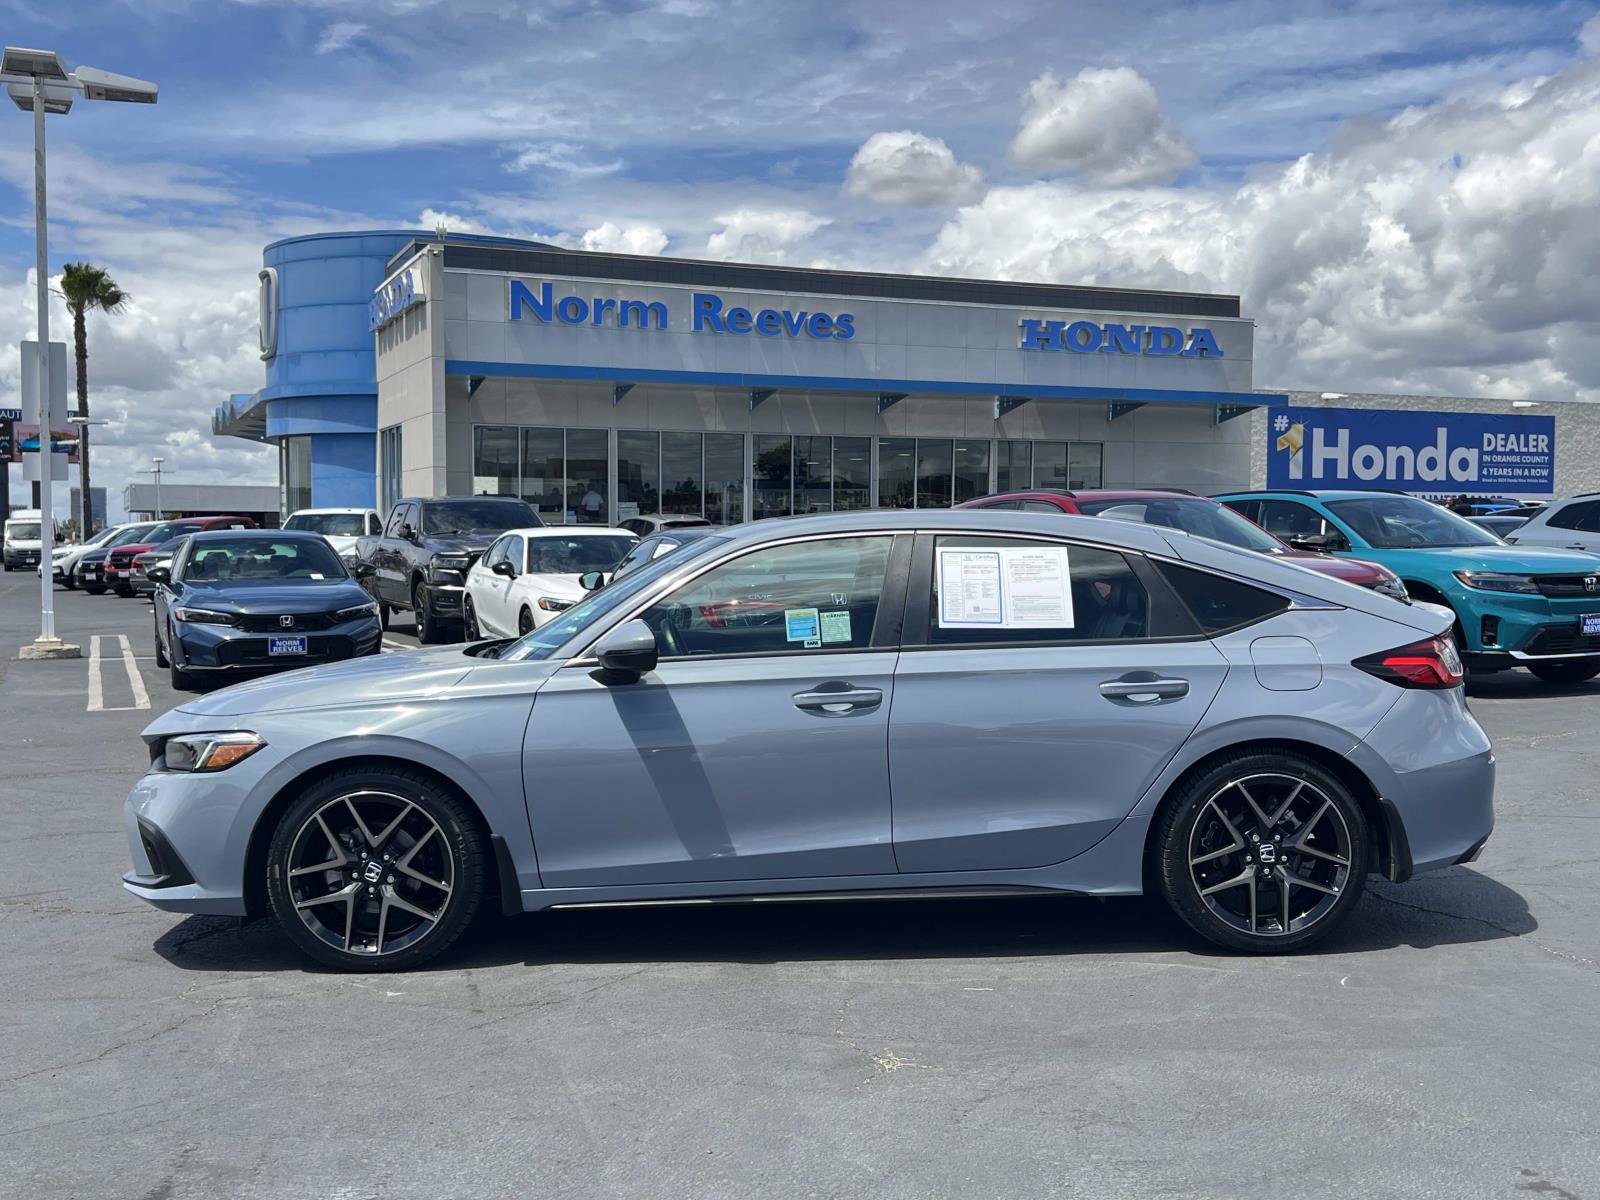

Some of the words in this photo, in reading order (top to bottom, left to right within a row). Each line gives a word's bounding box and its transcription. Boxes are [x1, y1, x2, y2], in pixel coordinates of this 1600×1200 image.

[509, 279, 669, 331] Norm
[692, 292, 856, 341] Reeves
[1017, 319, 1224, 358] HONDA
[0, 410, 22, 419] AUT
[1483, 433, 1549, 452] DEALER
[1312, 427, 1479, 481] Honda
[1492, 455, 1521, 463] ORANGE
[1482, 467, 1488, 476] 4
[1489, 467, 1512, 476] YEARS
[1513, 468, 1523, 476] IN
[1523, 468, 1530, 476] A
[1530, 468, 1549, 477] ROW
